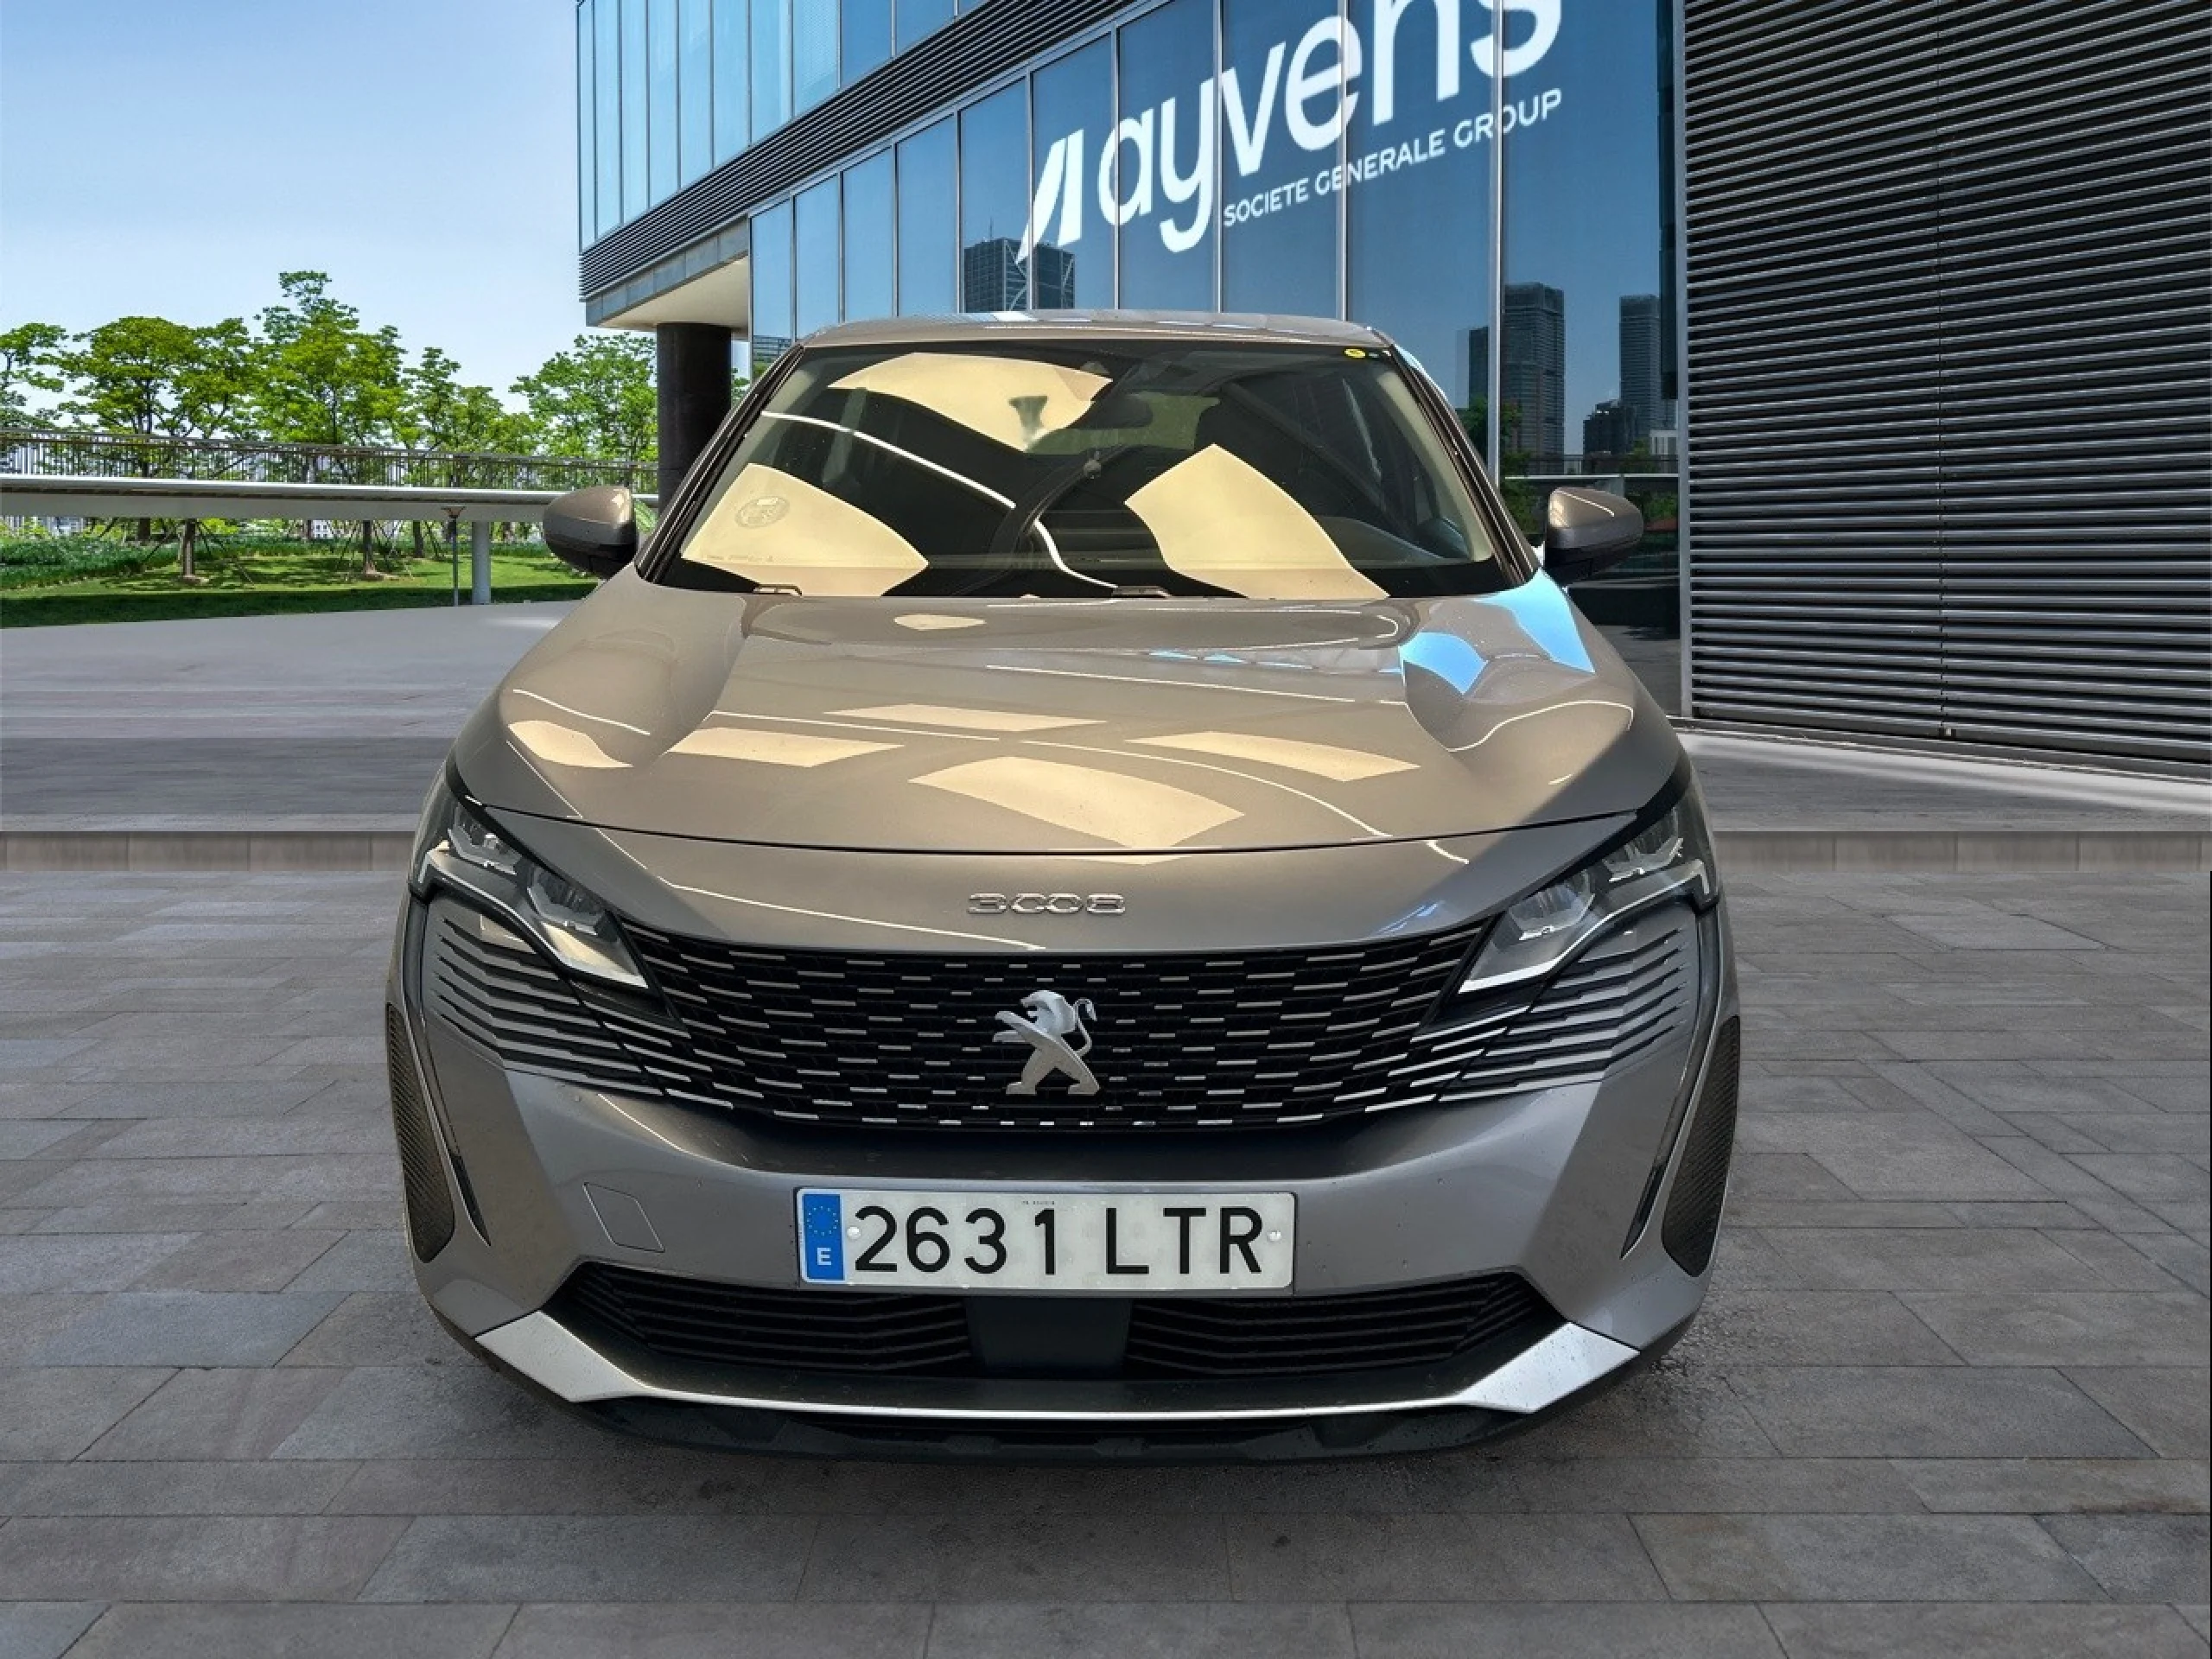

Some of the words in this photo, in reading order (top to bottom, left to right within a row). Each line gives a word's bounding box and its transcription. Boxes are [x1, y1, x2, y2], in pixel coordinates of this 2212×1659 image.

[1224, 178, 1309, 226] SOCIETE
[1315, 130, 1446, 195] GENERALE
[1453, 88, 1561, 148] GROUP
[968, 893, 1126, 913] 3008
[817, 1247, 832, 1266] E
[1106, 1207, 1263, 1275] LTR
